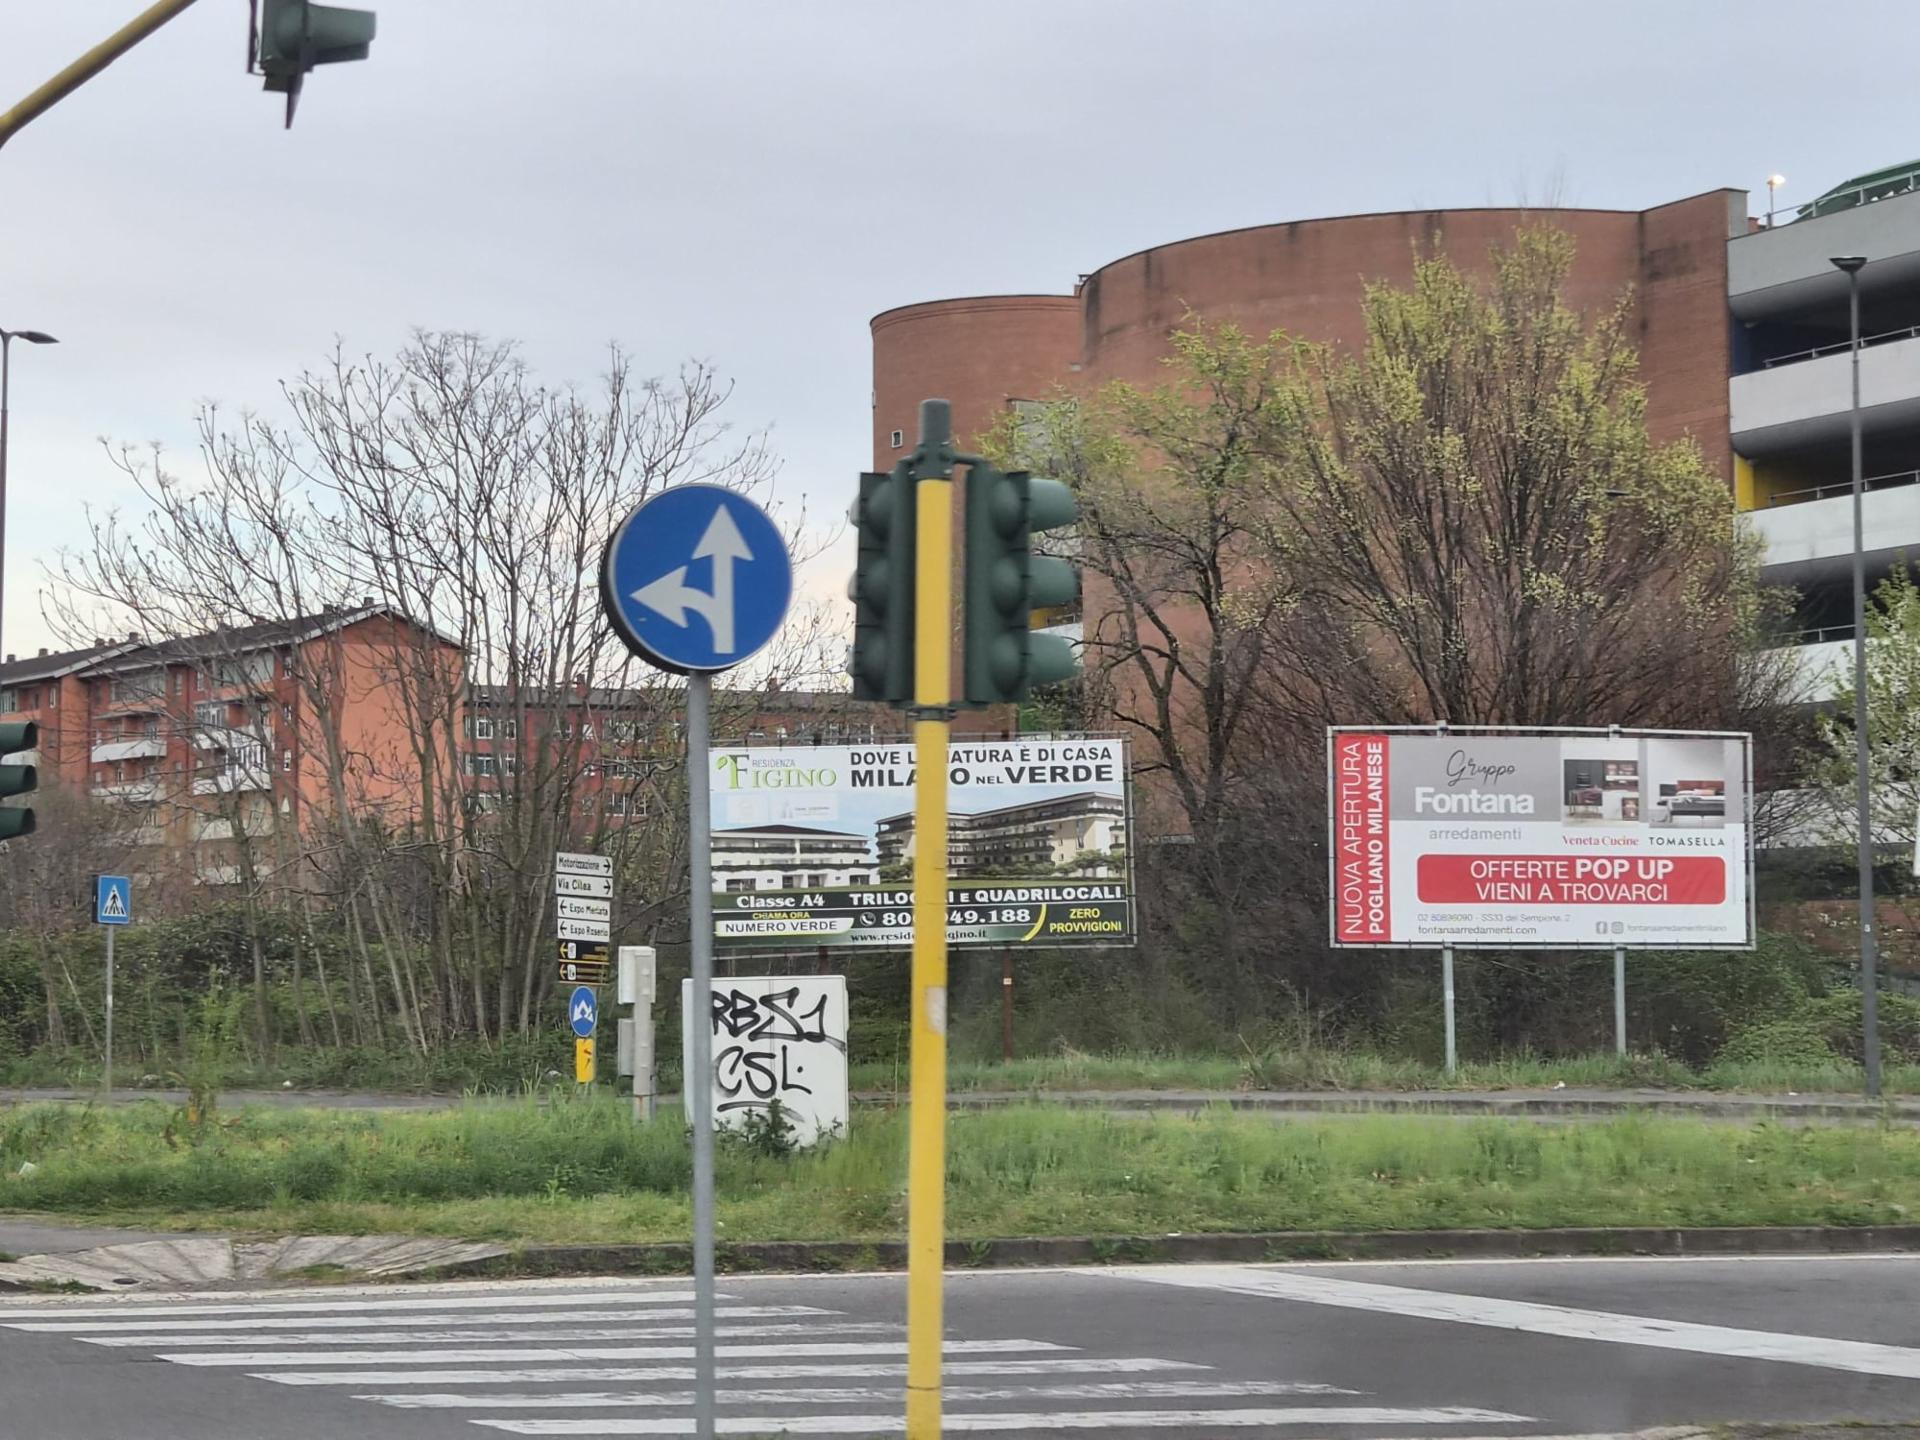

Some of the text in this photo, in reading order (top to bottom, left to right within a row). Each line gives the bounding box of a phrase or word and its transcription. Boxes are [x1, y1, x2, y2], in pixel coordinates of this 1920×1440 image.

[850, 751, 901, 765] DOVE
[1020, 745, 1031, 762] È
[1038, 748, 1055, 762] DI
[1062, 746, 1113, 761] CASA
[752, 759, 796, 768] RESIDENZA
[1446, 749, 1516, 786] Gruppo
[717, 754, 838, 789] FIGINO
[850, 764, 1114, 788] MILAO NEL VERDE
[1414, 786, 1535, 815] Fontana
[1342, 741, 1364, 935] NUOVA APERTURA
[1367, 742, 1385, 935] POGLIANO MILANESE
[1428, 826, 1522, 841] arredamenti
[1562, 835, 1640, 847] Veneta Cucine
[1648, 836, 1726, 847] TOMASELLA
[1470, 858, 1675, 880] OFFERTE POP UP
[557, 877, 569, 890] Via
[959, 893, 971, 903] E
[975, 886, 1122, 903] QUADRILOCALI
[1476, 882, 1669, 902] VIENI A TROVARCI
[569, 902, 585, 914] Expo
[736, 893, 826, 909] Classe A4
[751, 911, 811, 920] CHIAMA ORA
[1069, 907, 1101, 919] ZERO
[570, 923, 586, 936] Expo
[725, 920, 838, 933] NUMERO VERDE
[1049, 921, 1123, 934] PROVVIGIONI
[1418, 925, 1537, 934] fontanaarredamenti.com
